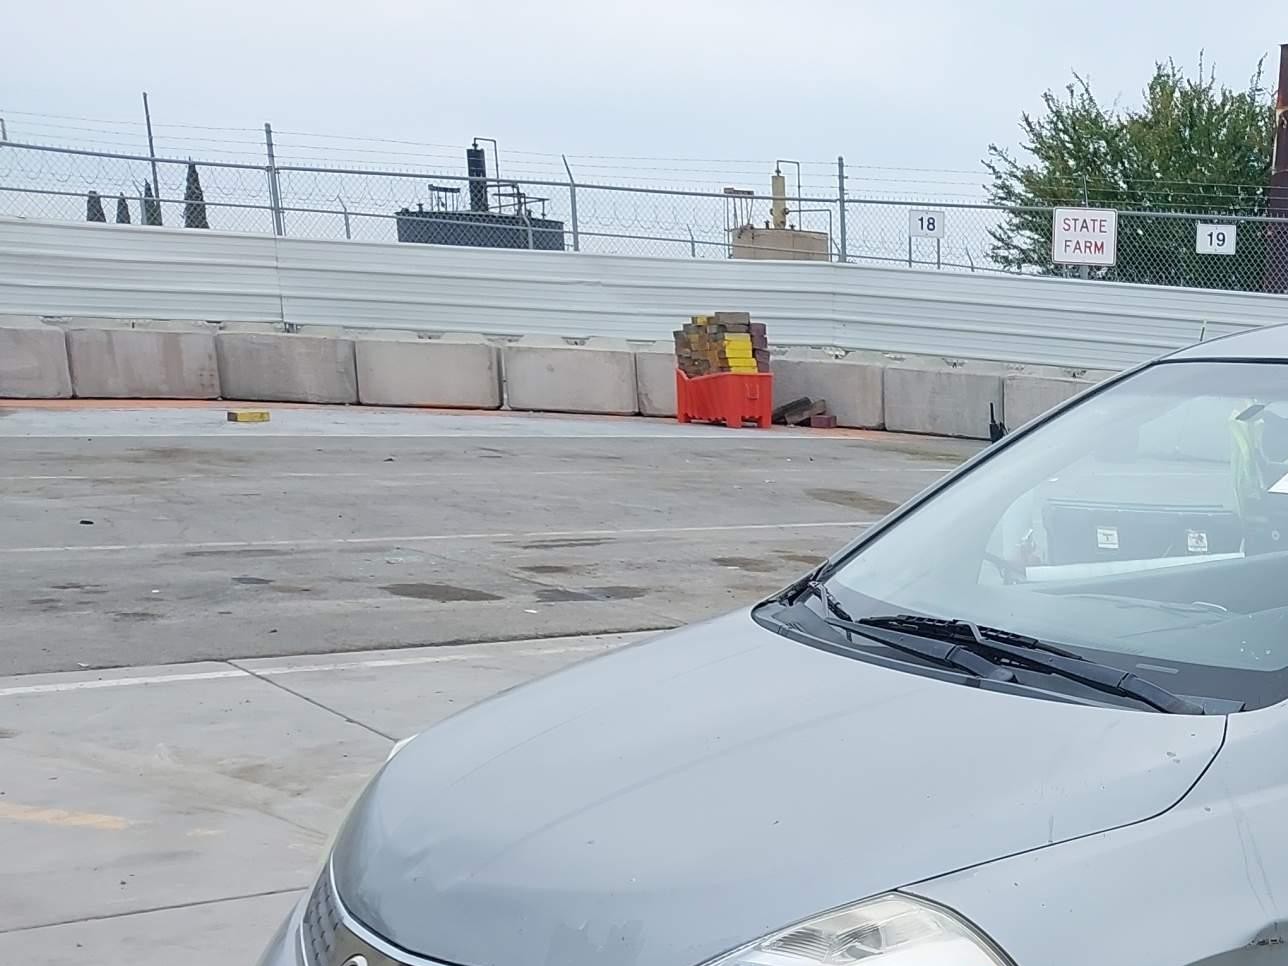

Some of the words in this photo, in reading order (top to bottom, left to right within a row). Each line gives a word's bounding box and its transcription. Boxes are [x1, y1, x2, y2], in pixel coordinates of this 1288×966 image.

[918, 216, 936, 231] 18
[1062, 217, 1108, 233] STATE
[1064, 239, 1105, 255] FARM
[1207, 231, 1226, 247] 19
